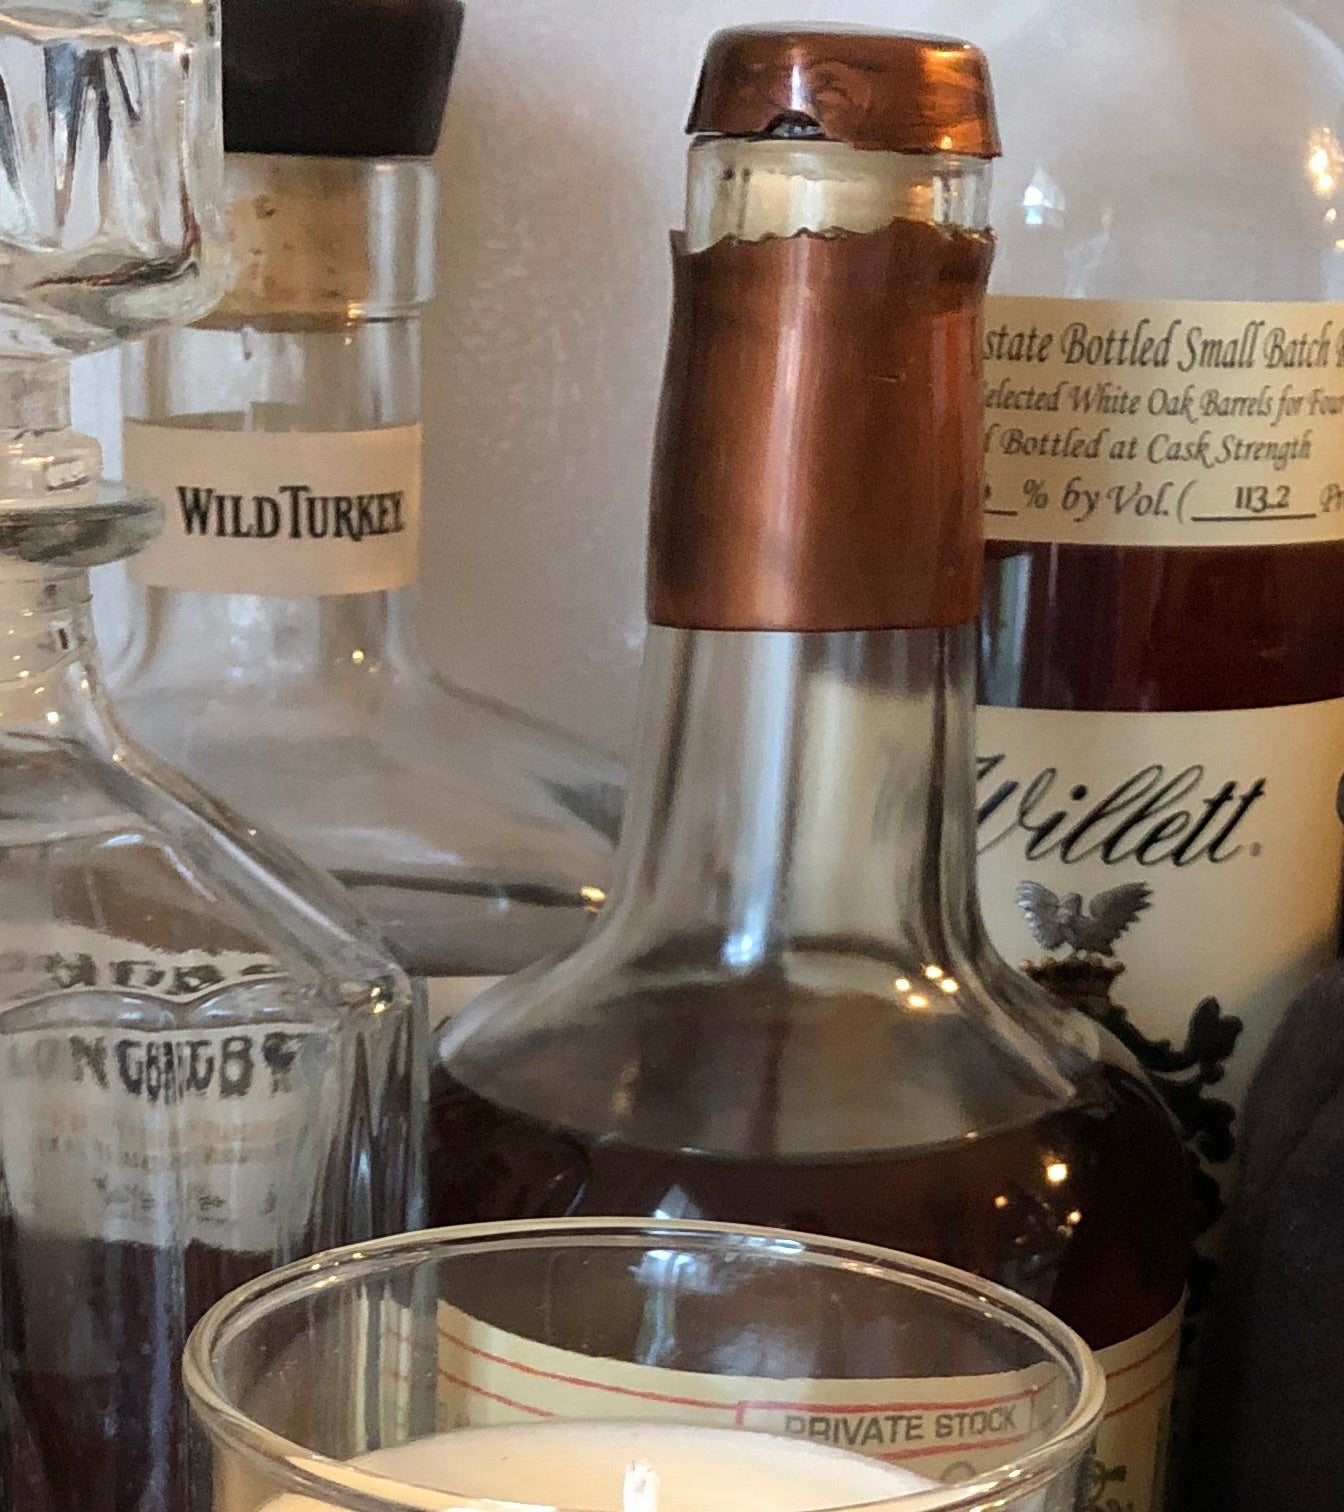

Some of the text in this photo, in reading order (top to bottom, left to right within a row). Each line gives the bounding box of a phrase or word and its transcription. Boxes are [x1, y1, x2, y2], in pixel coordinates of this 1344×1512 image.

[1060, 318, 1182, 367] Bottled
[1177, 320, 1265, 372] Small
[1263, 321, 1333, 368] Batch
[983, 377, 1069, 411] elected
[1069, 380, 1142, 413] White
[1147, 384, 1199, 424] Oak
[1200, 385, 1273, 417] Barrels
[1270, 384, 1304, 427] for
[1000, 427, 1111, 459] Bottled
[1109, 436, 1139, 460] at
[1147, 430, 1214, 469] Cask
[1216, 429, 1312, 471] Strength
[1061, 476, 1100, 522] by
[784, 1405, 1017, 1446] PRIVATE STOCK
